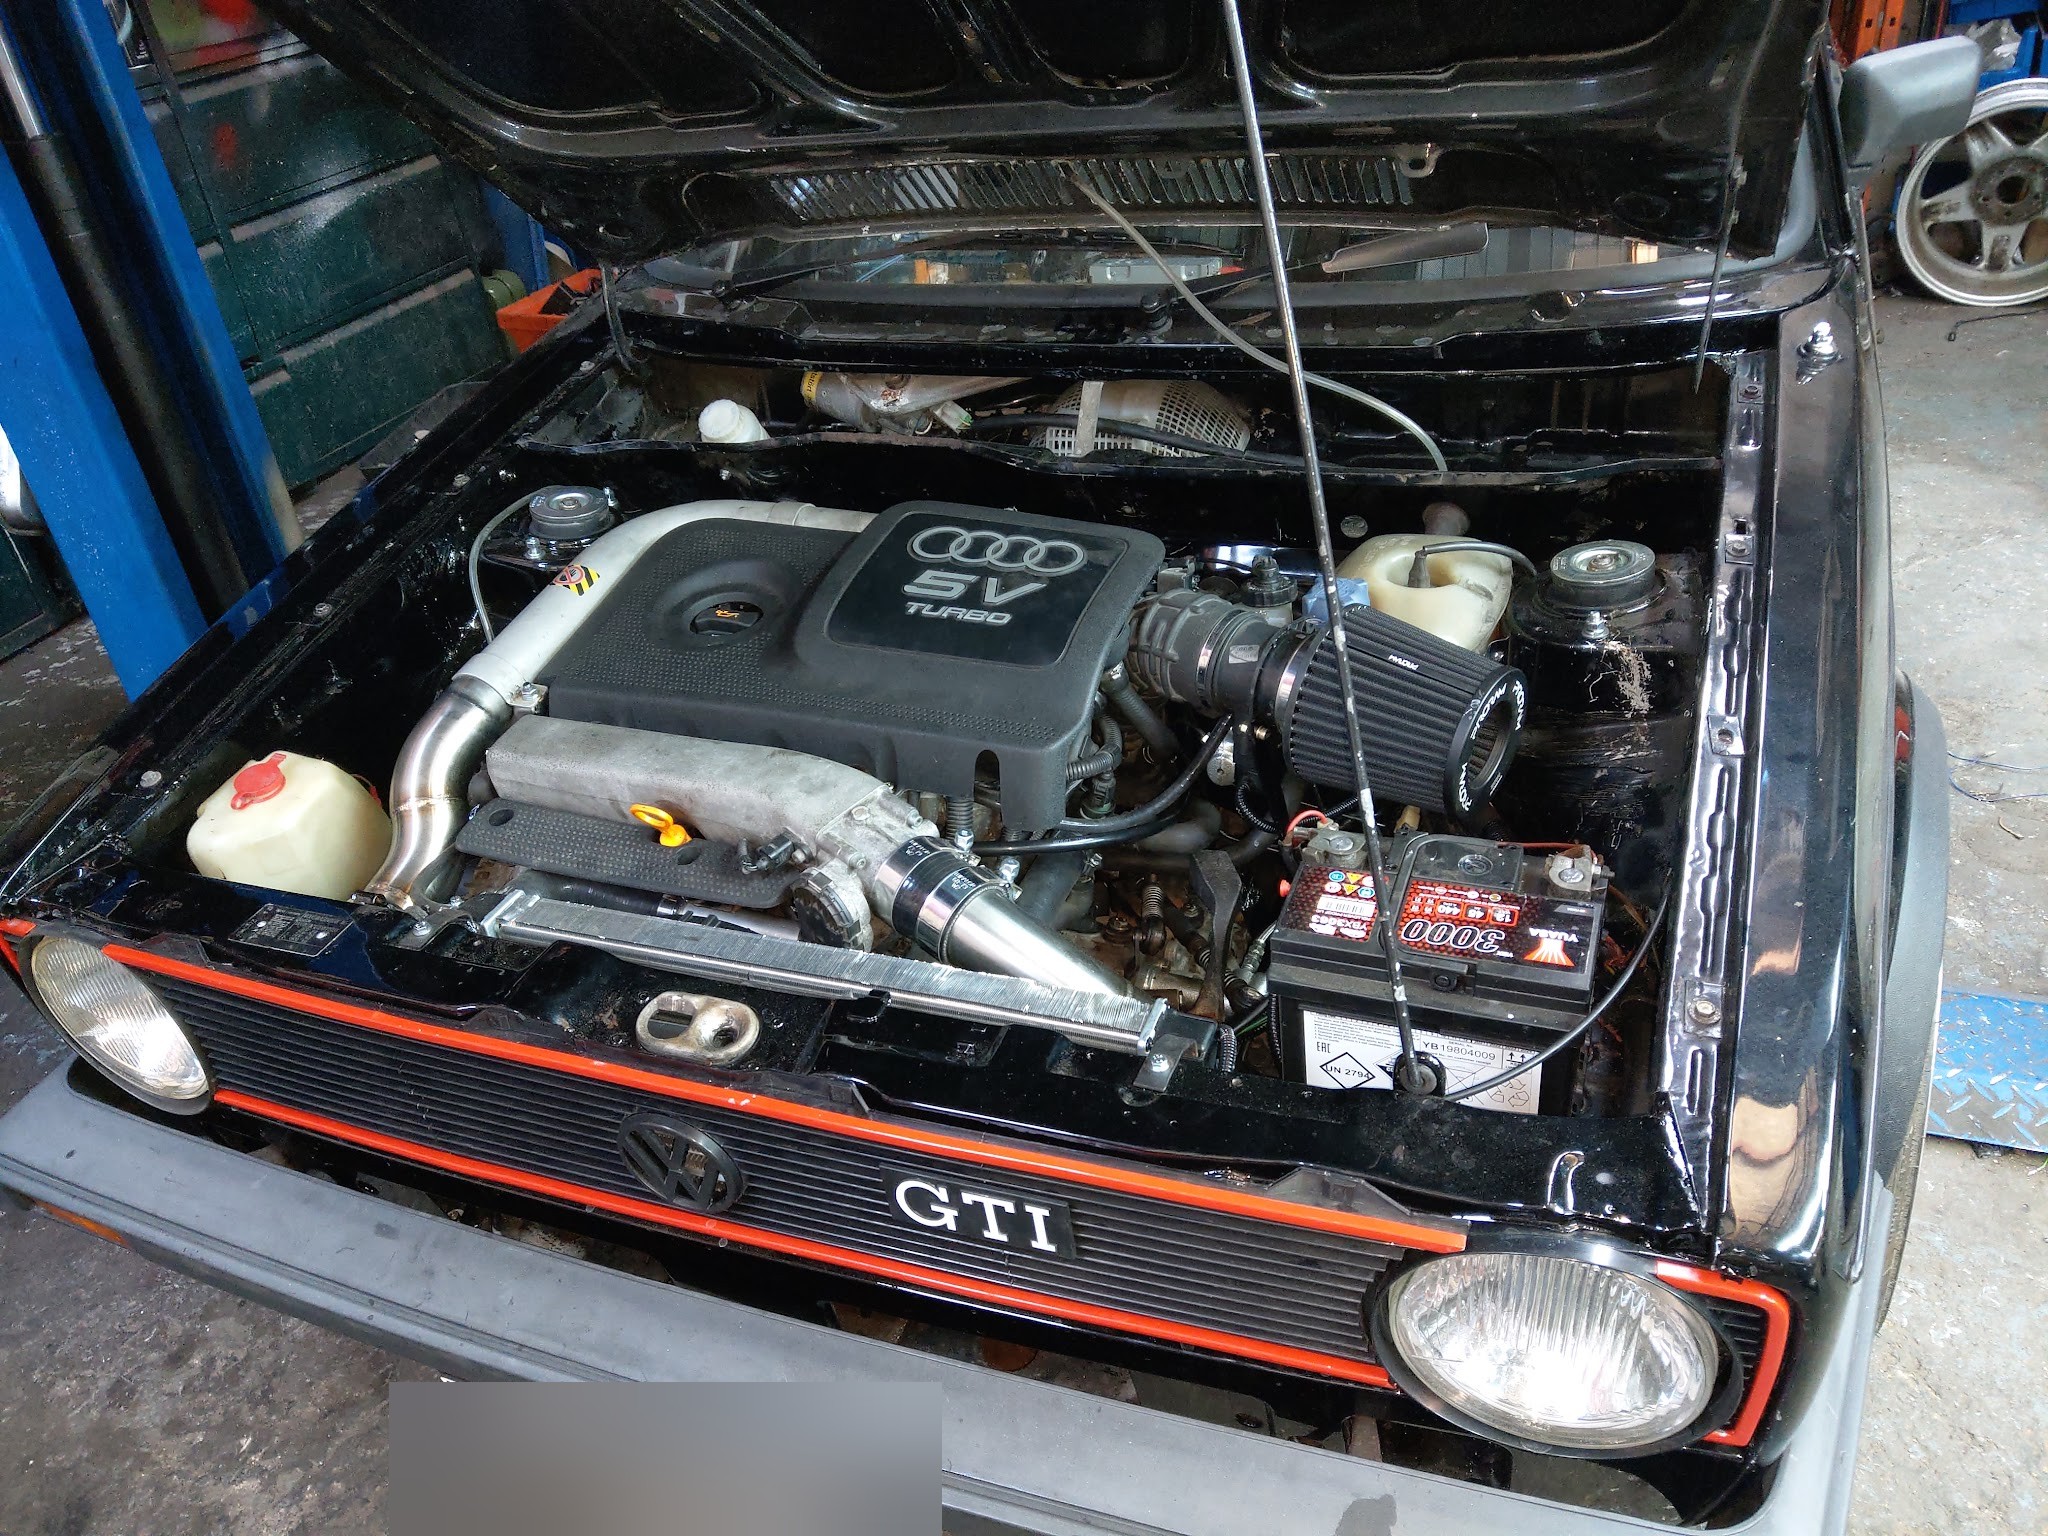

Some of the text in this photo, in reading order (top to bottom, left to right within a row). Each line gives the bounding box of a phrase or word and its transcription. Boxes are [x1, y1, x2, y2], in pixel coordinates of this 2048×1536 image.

[903, 569, 1048, 606] 5V
[905, 601, 1013, 626] TURBO
[1401, 918, 1506, 953] 3000
[1528, 927, 1579, 943] YUASA
[1344, 1068, 1370, 1080] 2794
[895, 1179, 1057, 1252] GTI
